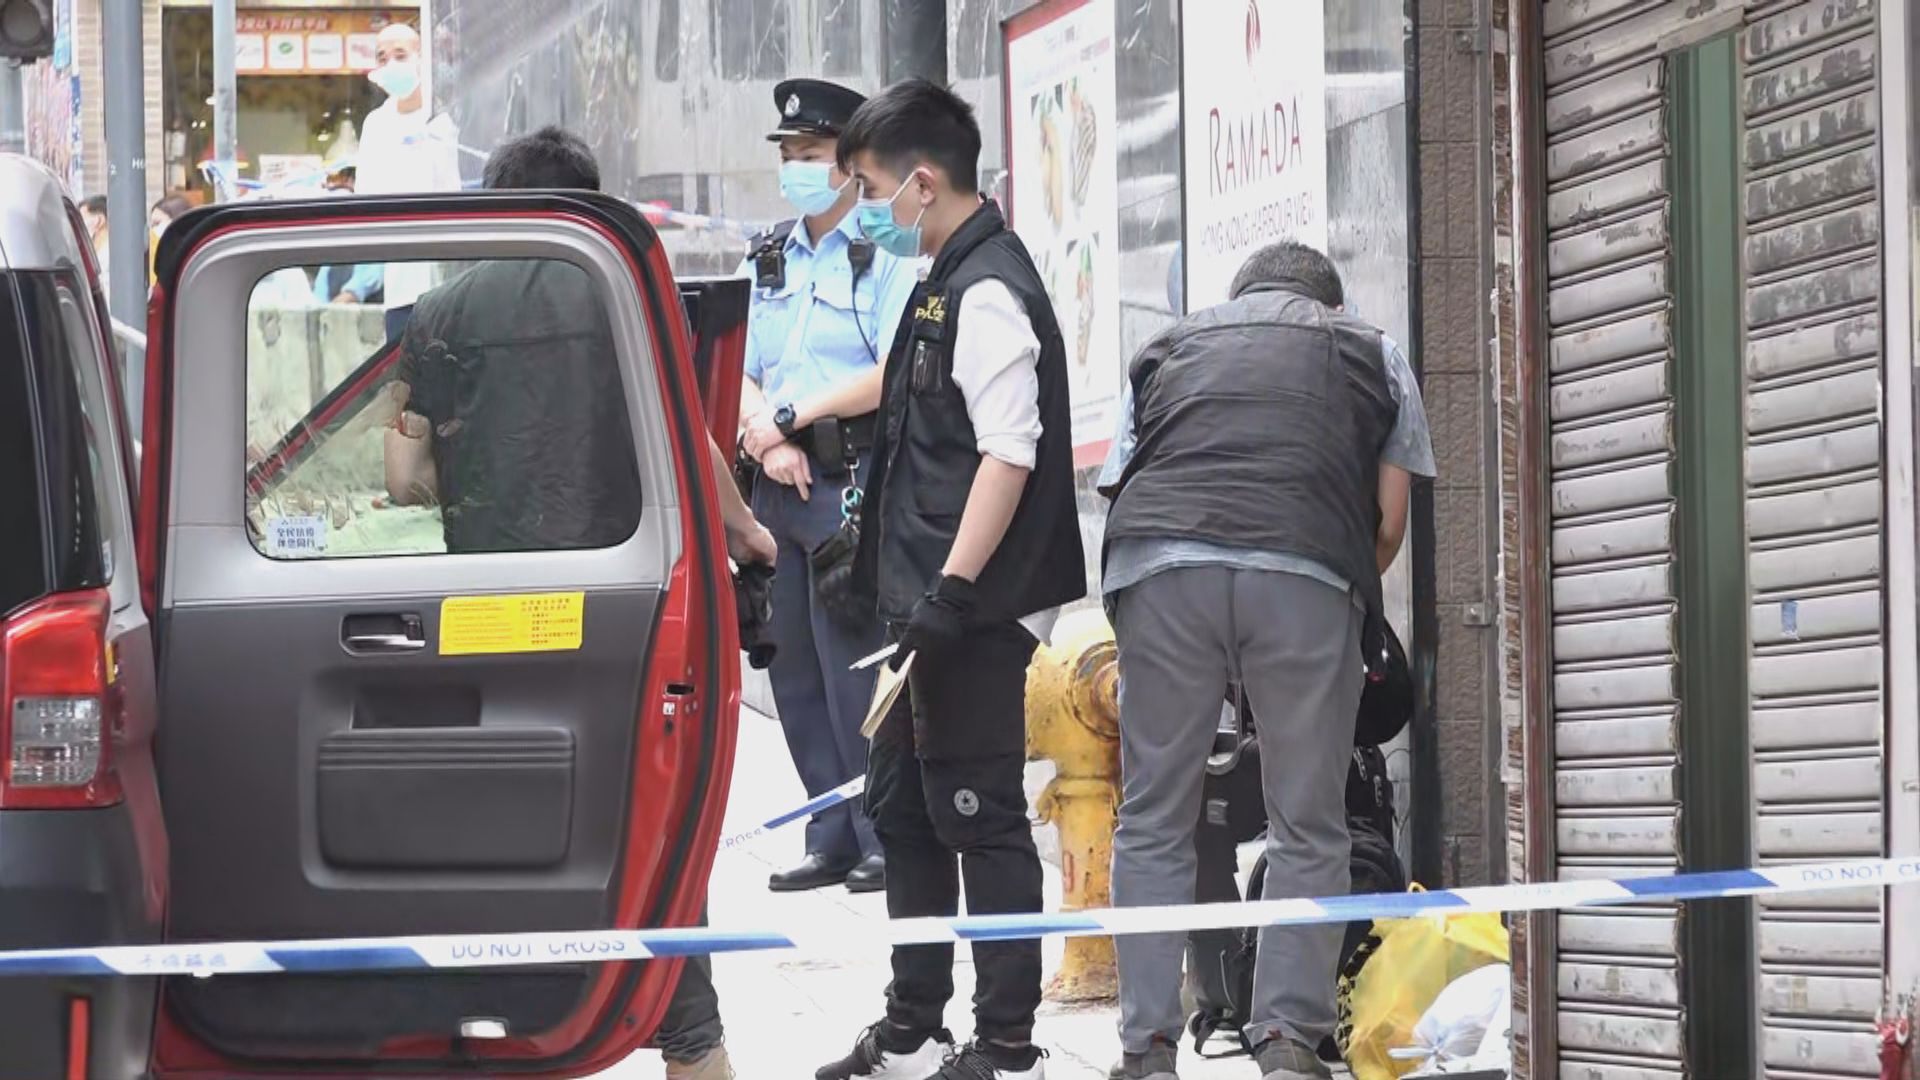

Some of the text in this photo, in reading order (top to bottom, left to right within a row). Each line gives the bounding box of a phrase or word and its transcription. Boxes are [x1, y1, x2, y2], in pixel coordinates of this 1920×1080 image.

[1209, 95, 1302, 198] RAMADA
[1802, 868, 1834, 881] DO
[1840, 862, 1884, 879] NOT
